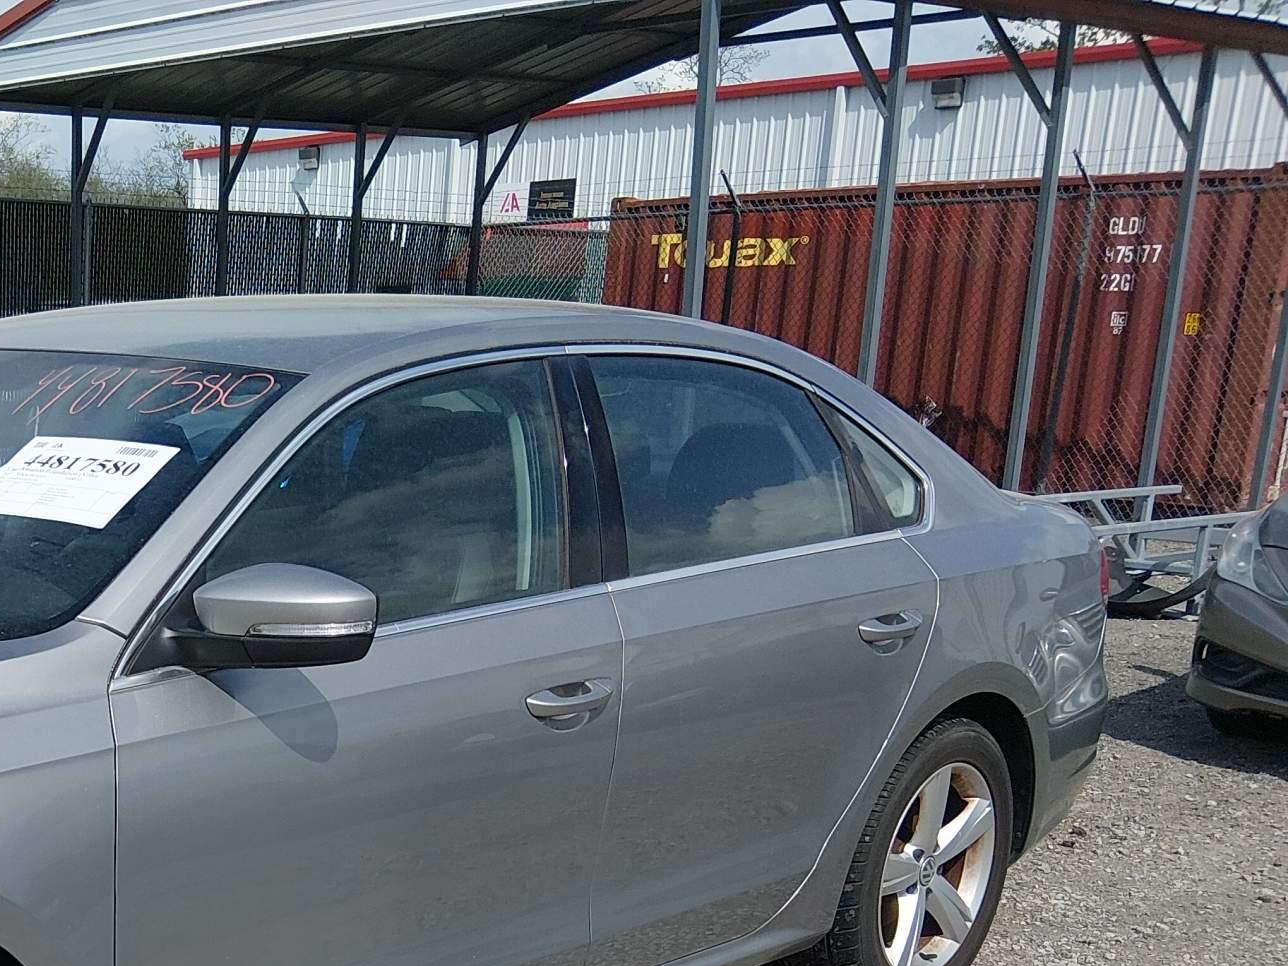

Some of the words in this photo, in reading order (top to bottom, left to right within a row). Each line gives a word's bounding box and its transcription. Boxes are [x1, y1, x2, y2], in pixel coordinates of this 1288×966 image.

[1108, 216, 1147, 236] GLDU
[1103, 244, 1163, 264] 975177
[11, 366, 276, 426] 44817580
[23, 454, 142, 477] 44817580
